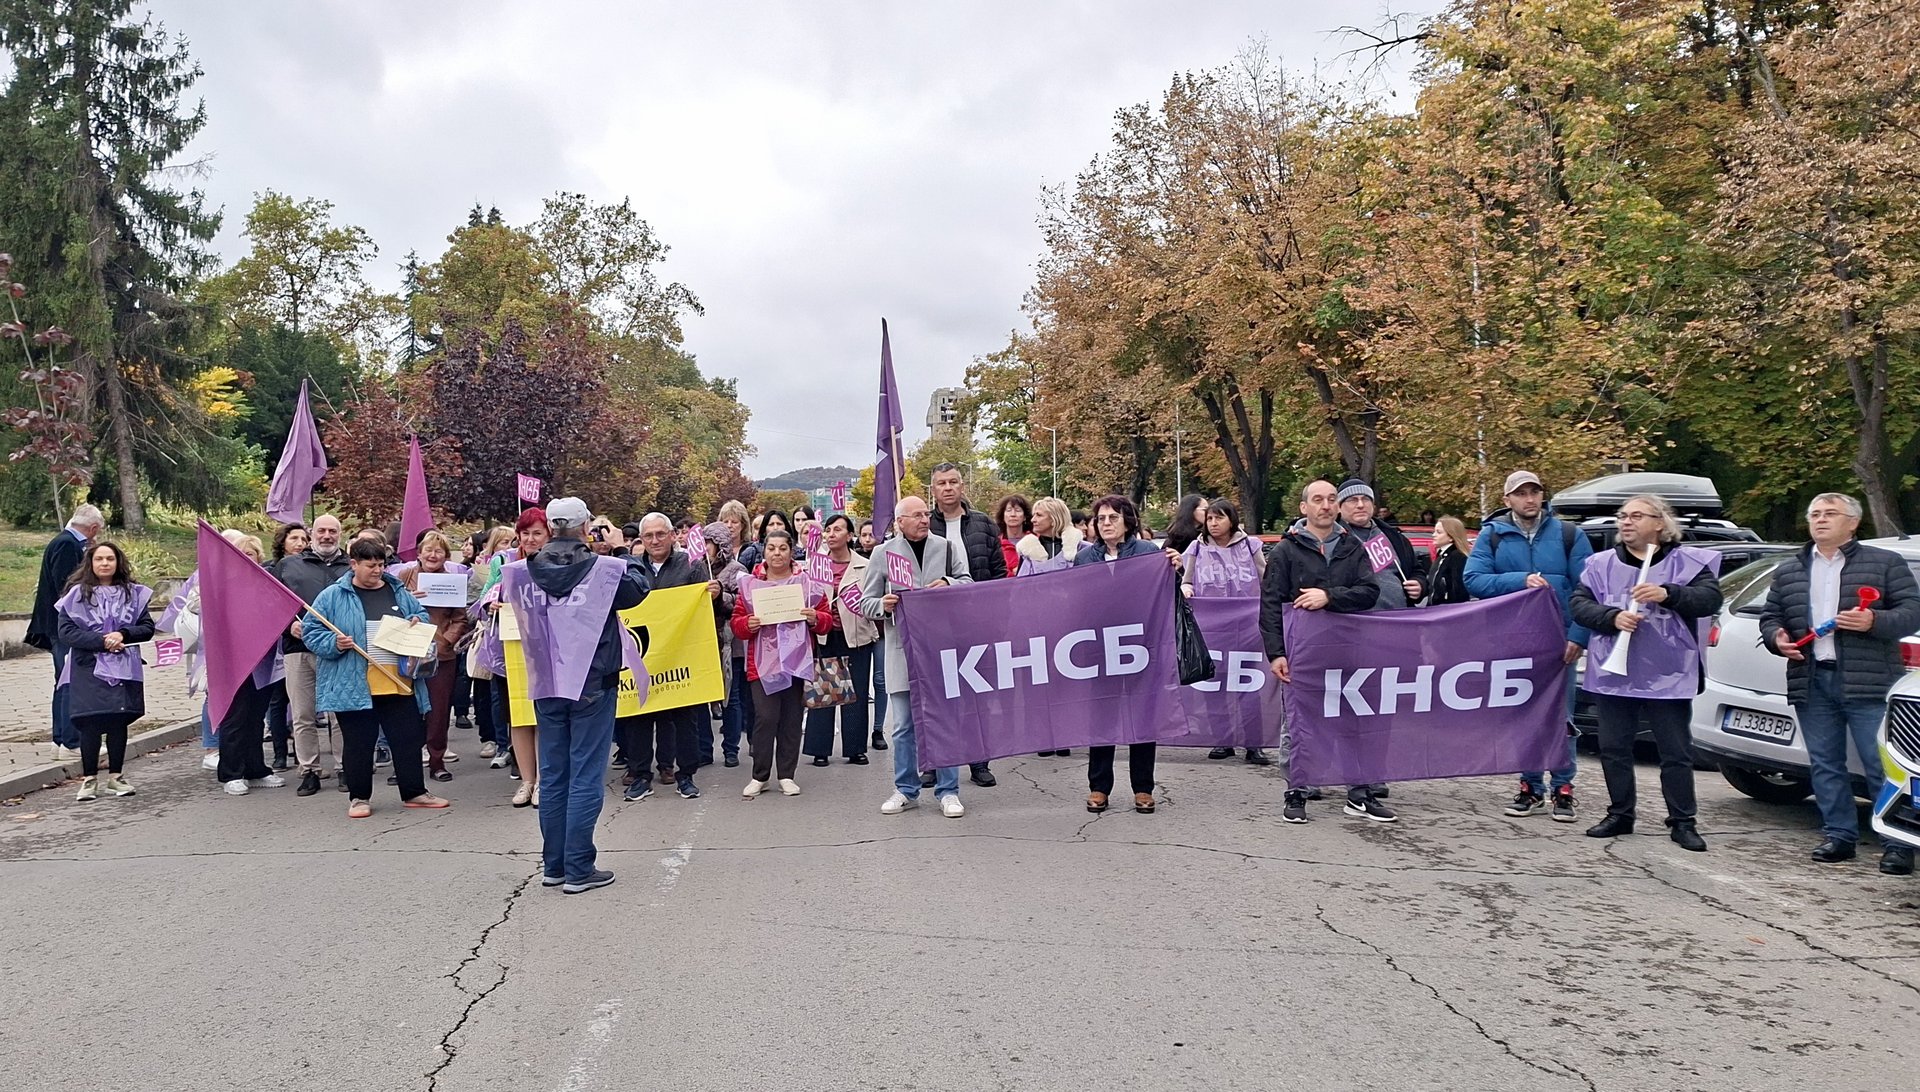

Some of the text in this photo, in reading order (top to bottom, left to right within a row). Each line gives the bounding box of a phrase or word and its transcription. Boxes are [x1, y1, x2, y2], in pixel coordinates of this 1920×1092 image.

[810, 554, 834, 583] КНСБ
[887, 554, 913, 587] КНСБ
[940, 623, 1150, 699] КНСБ
[1323, 657, 1534, 718] КНСБ
